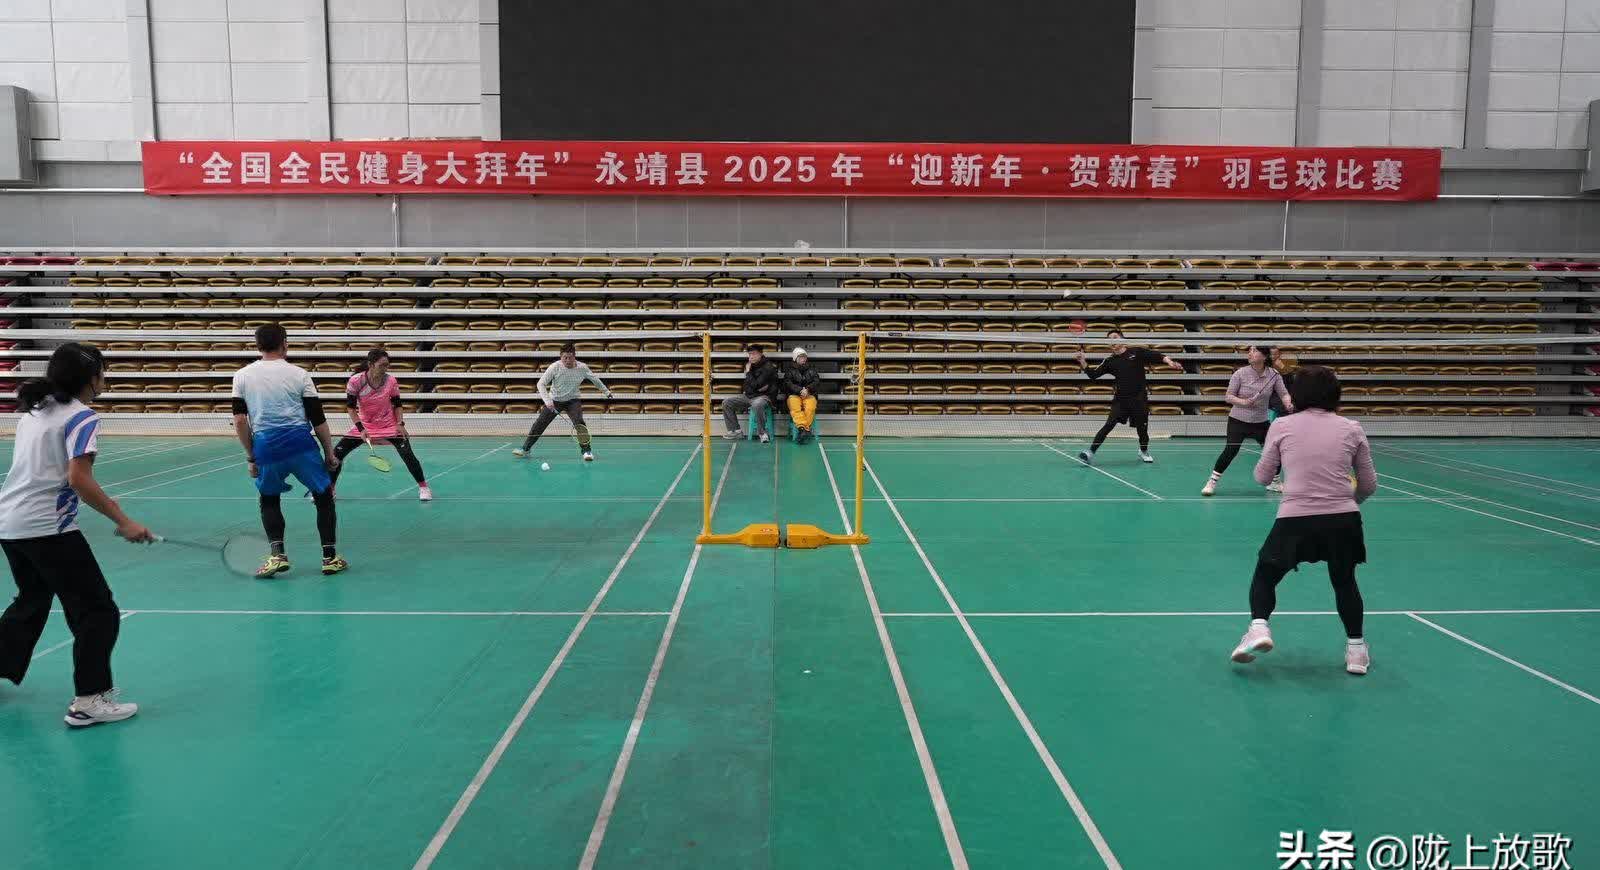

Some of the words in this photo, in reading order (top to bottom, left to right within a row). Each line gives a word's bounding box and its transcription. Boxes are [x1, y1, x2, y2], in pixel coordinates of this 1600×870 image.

[179, 151, 569, 186] “全国全民健身大拜年”
[594, 151, 708, 186] 永靖县
[724, 155, 816, 183] 2025
[830, 152, 864, 186] 年
[1221, 157, 1404, 192] 羽毛球比赛
